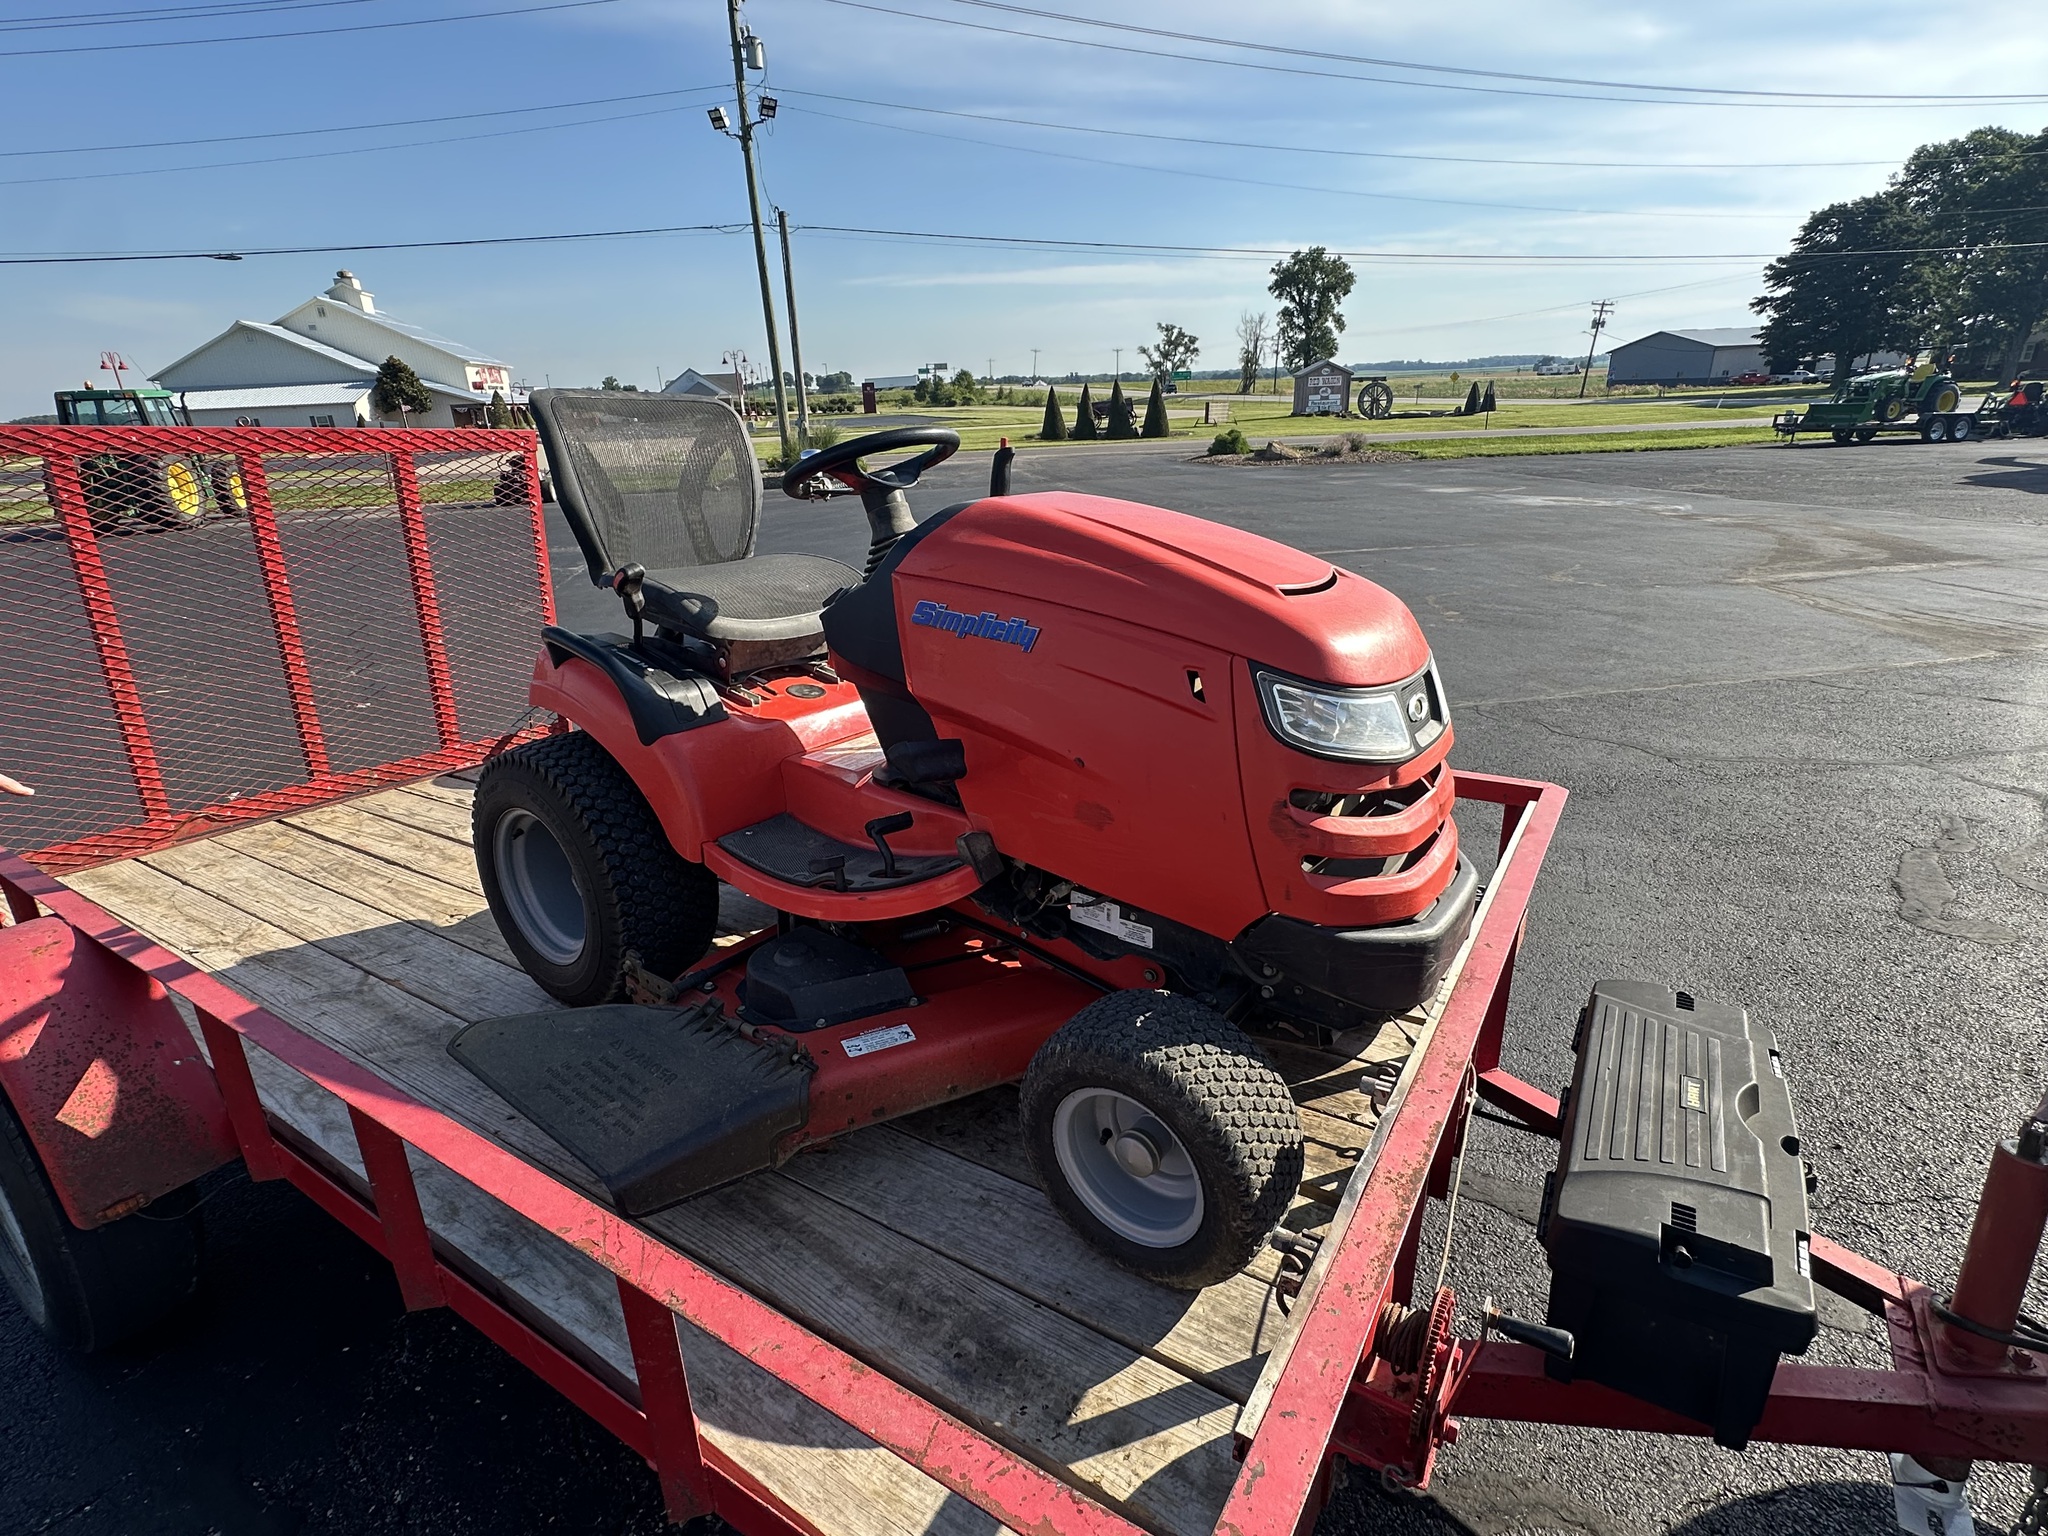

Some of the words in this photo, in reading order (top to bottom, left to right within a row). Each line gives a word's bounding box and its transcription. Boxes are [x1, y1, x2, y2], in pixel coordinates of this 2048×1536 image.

[911, 600, 1042, 653] Simplicity
[623, 1046, 679, 1086] DANGER
[1687, 1081, 1701, 1108] HART
